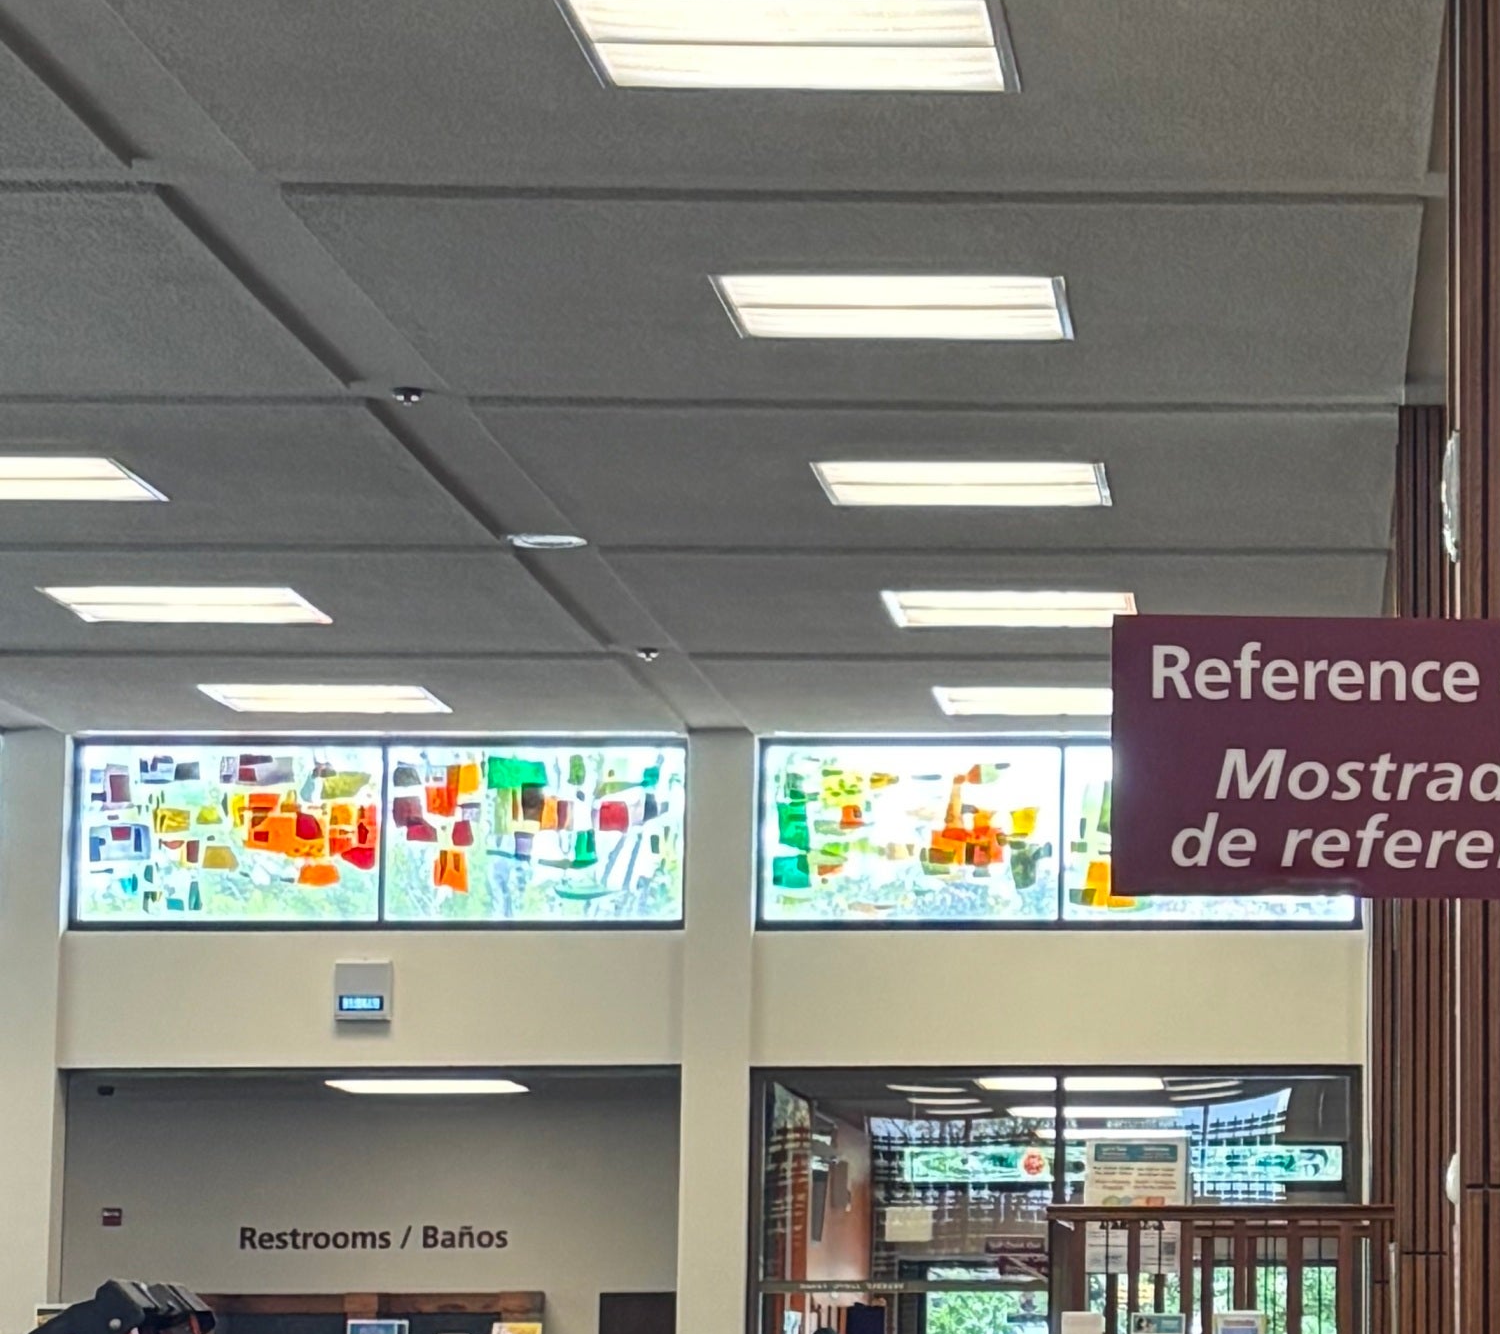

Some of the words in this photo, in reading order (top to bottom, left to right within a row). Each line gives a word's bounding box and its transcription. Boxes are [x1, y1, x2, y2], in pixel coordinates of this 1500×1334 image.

[1150, 641, 1480, 703] Reference
[1170, 812, 1257, 869] de
[238, 1225, 392, 1251] Restrooms
[399, 1224, 413, 1250] /
[421, 1224, 509, 1250] Baños
